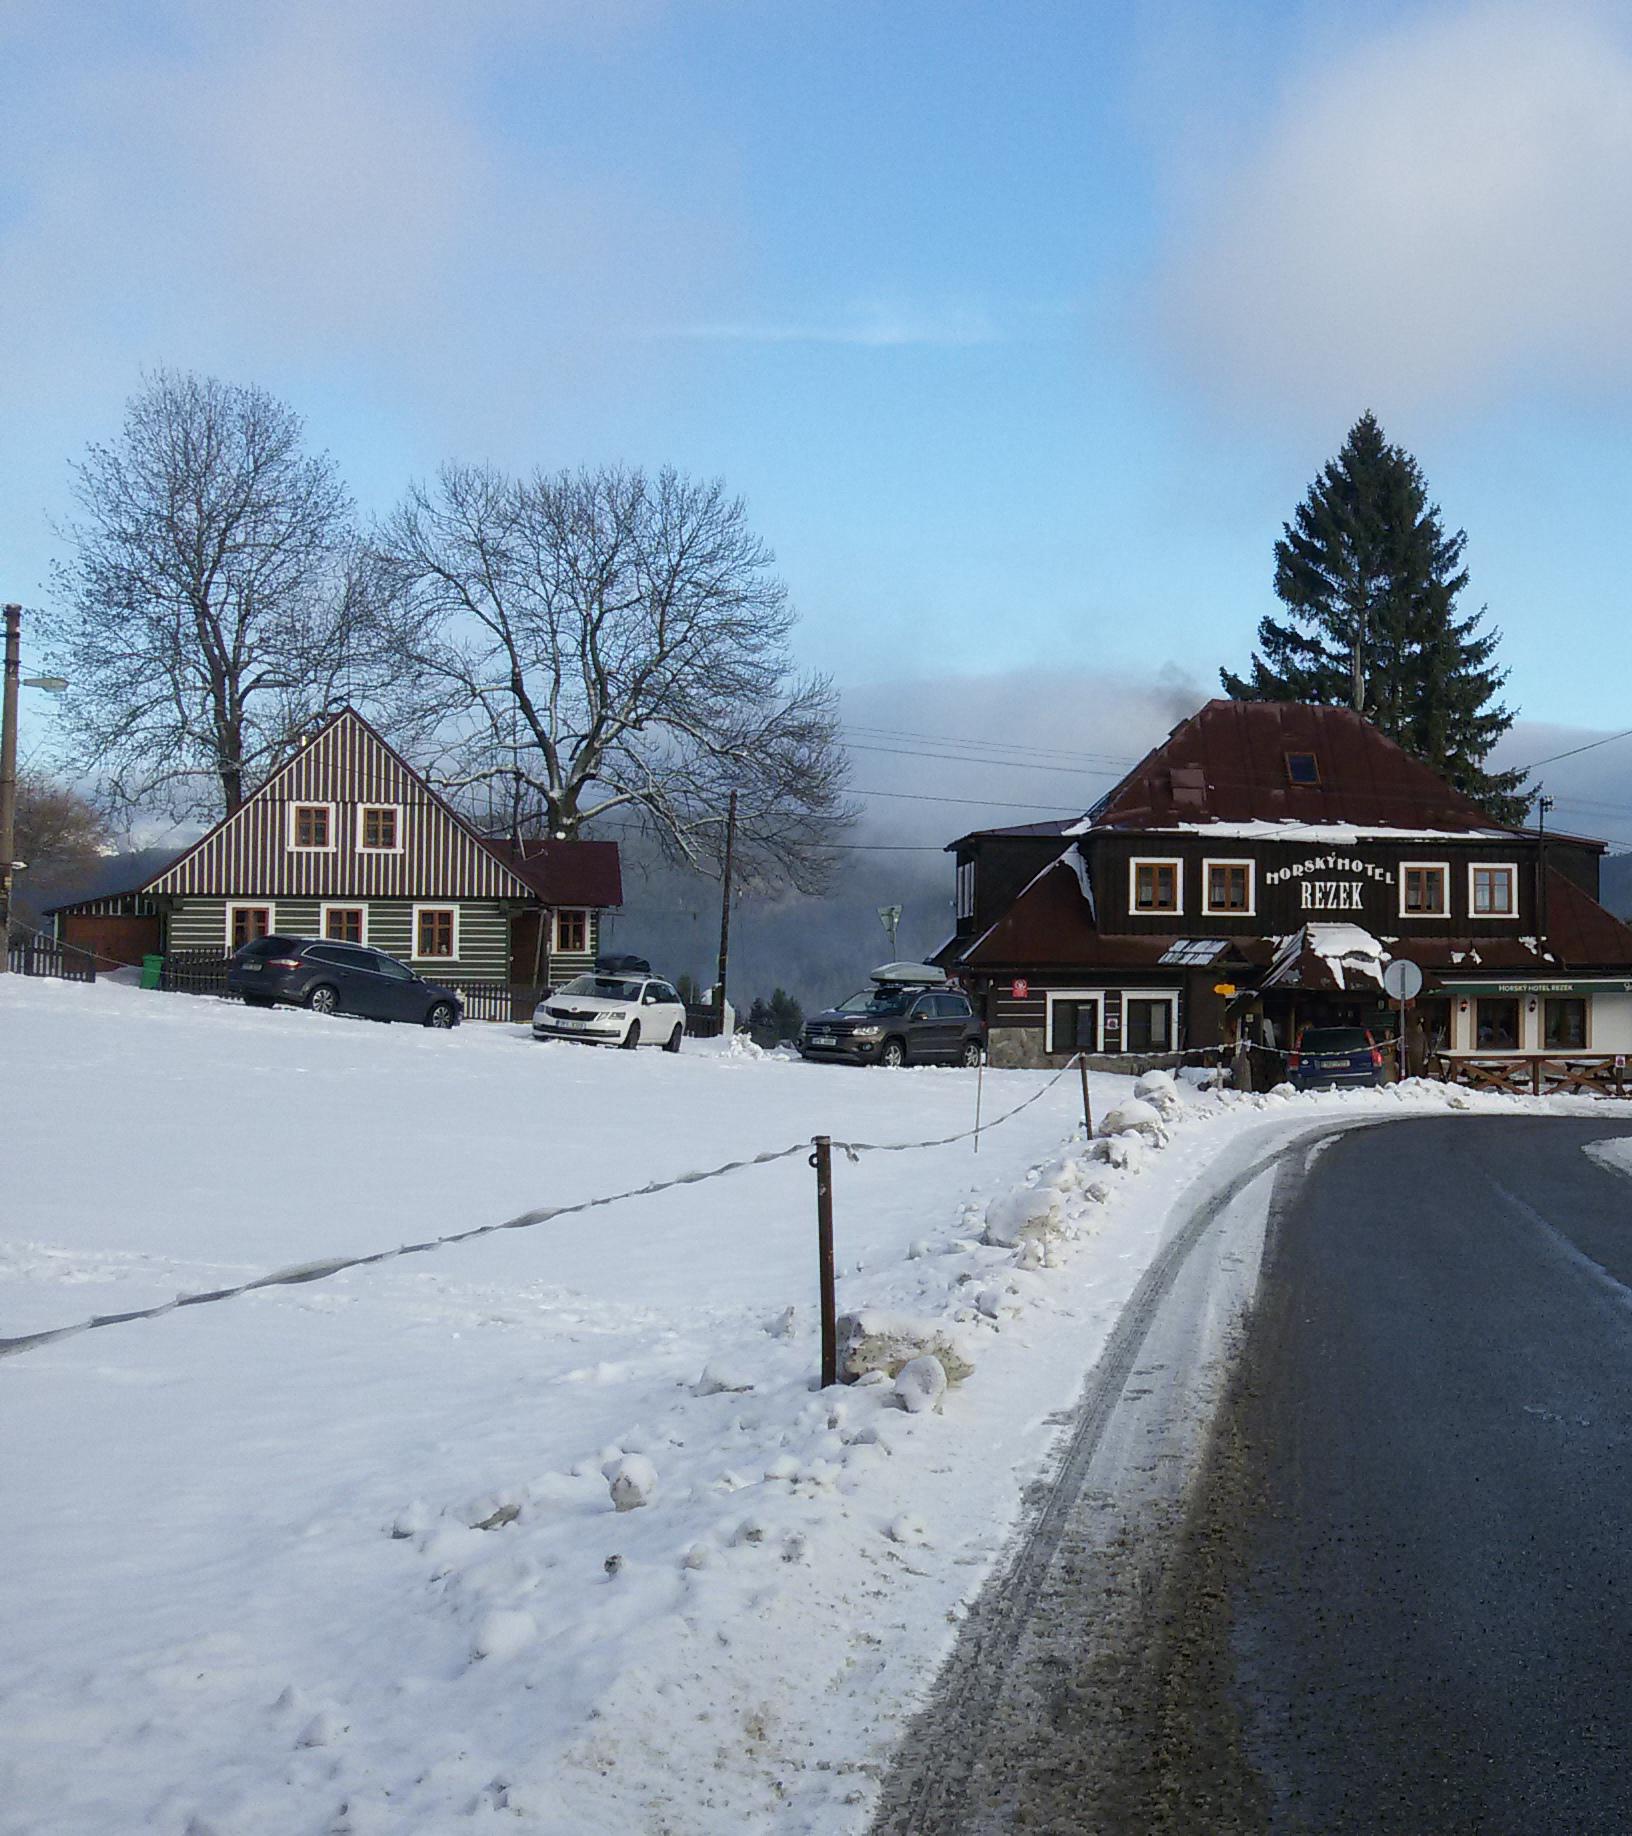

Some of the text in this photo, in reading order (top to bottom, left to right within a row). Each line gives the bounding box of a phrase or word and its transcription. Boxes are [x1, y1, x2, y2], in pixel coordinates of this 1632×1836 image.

[1266, 851, 1395, 885] HORSKÝ HOTEL
[1300, 881, 1364, 909] REZEK
[1498, 983, 1528, 992] HORSKÝ
